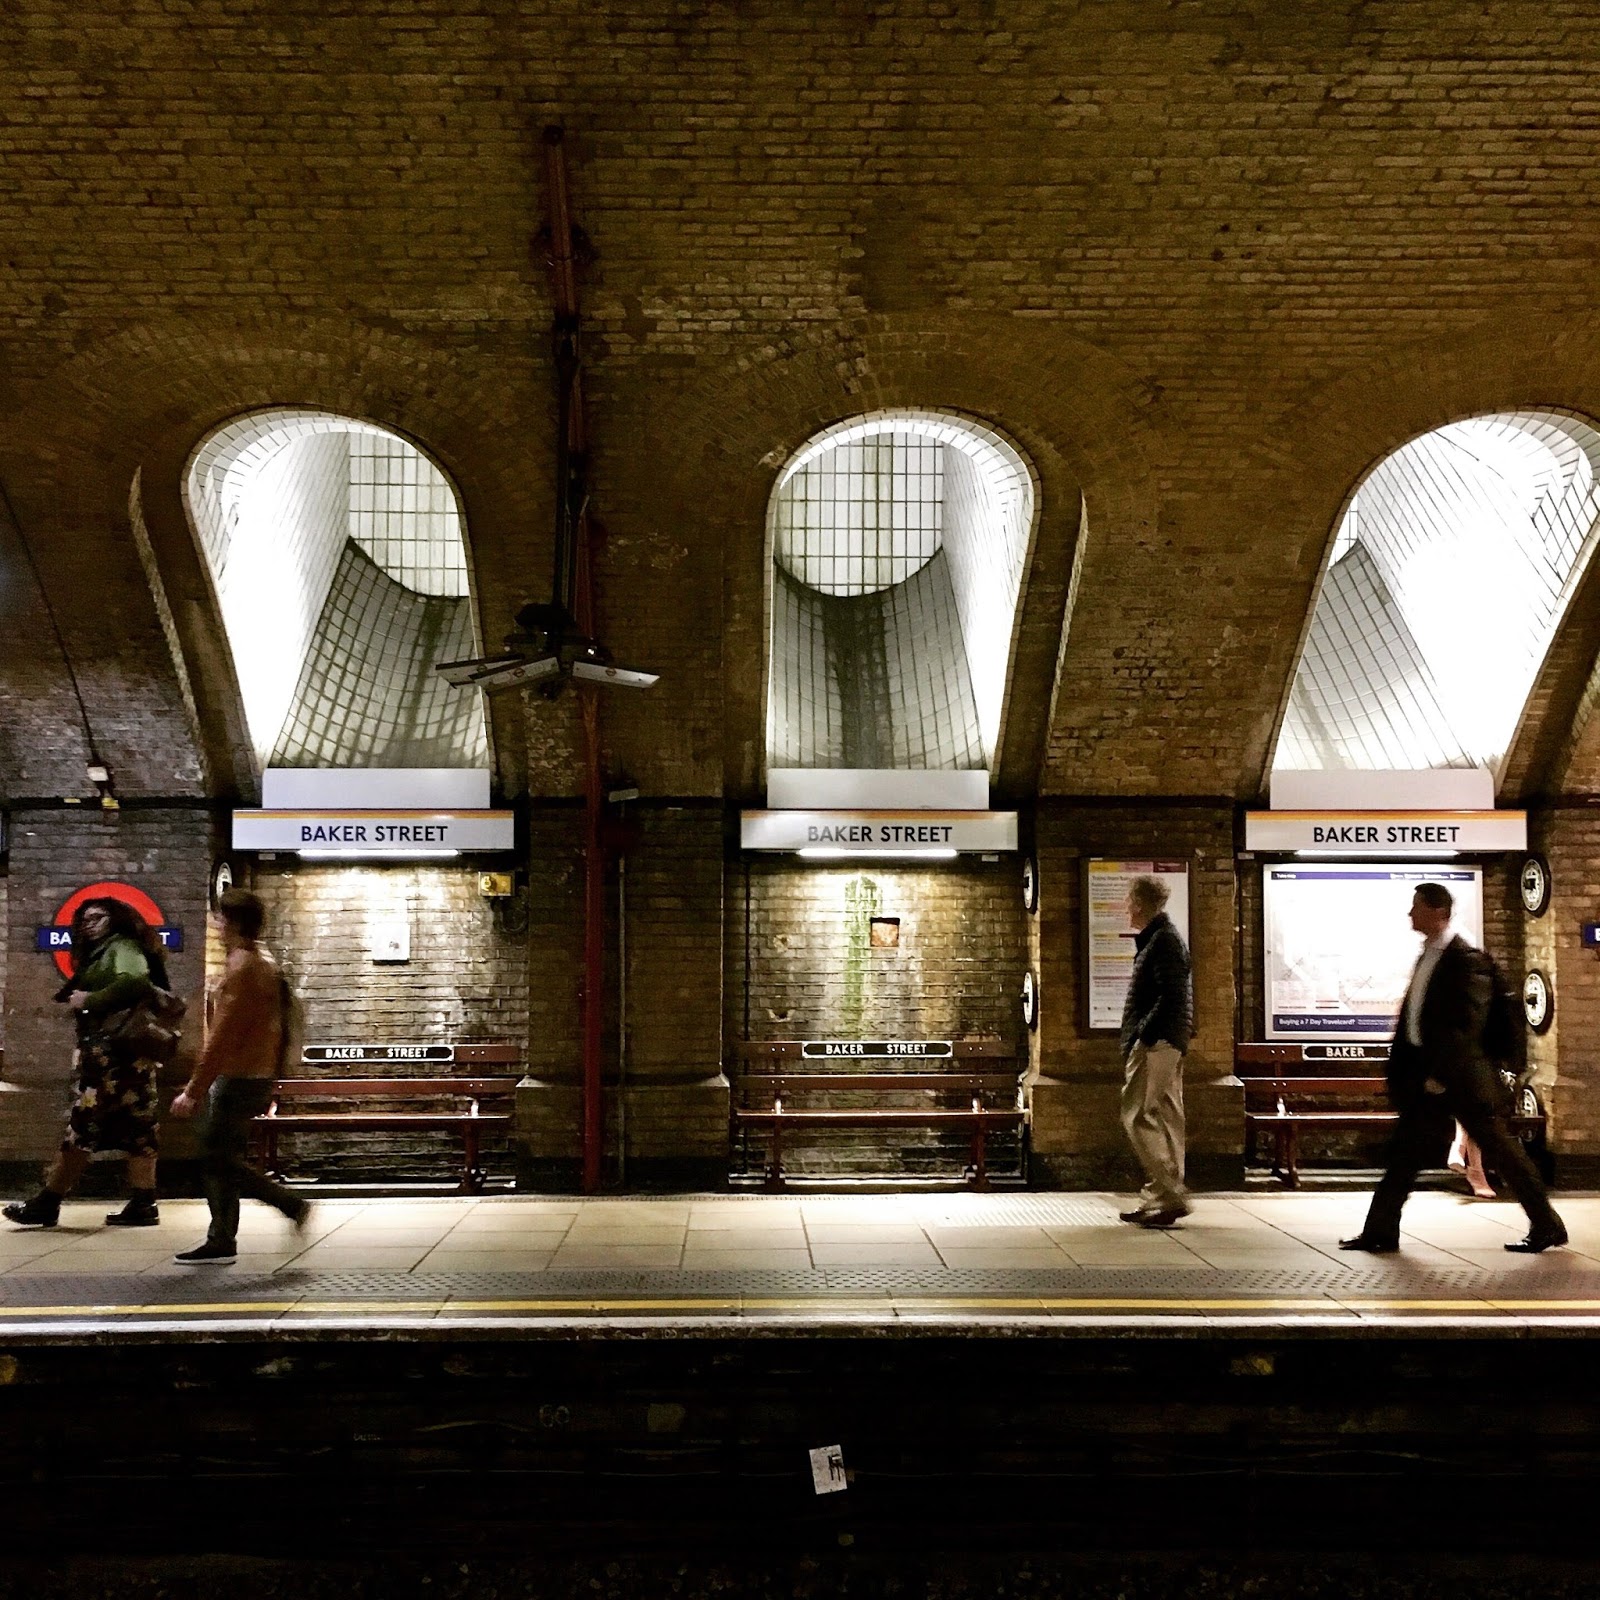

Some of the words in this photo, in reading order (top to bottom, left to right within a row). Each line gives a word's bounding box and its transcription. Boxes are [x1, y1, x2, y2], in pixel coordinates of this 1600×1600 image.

[301, 826, 367, 841] BAKER
[375, 826, 448, 841] STREET
[808, 826, 873, 842] BAKER
[880, 826, 953, 842] STREET
[1313, 827, 1379, 842] BAKER
[1387, 827, 1460, 842] STREET
[1279, 1018, 1300, 1026] Buying
[1310, 1018, 1321, 1026] Day
[325, 1048, 365, 1059] BAKER
[386, 1047, 429, 1058] STREET
[825, 1044, 864, 1055] BAKER
[886, 1044, 927, 1054] STREET
[1325, 1047, 1365, 1057] BAKER
